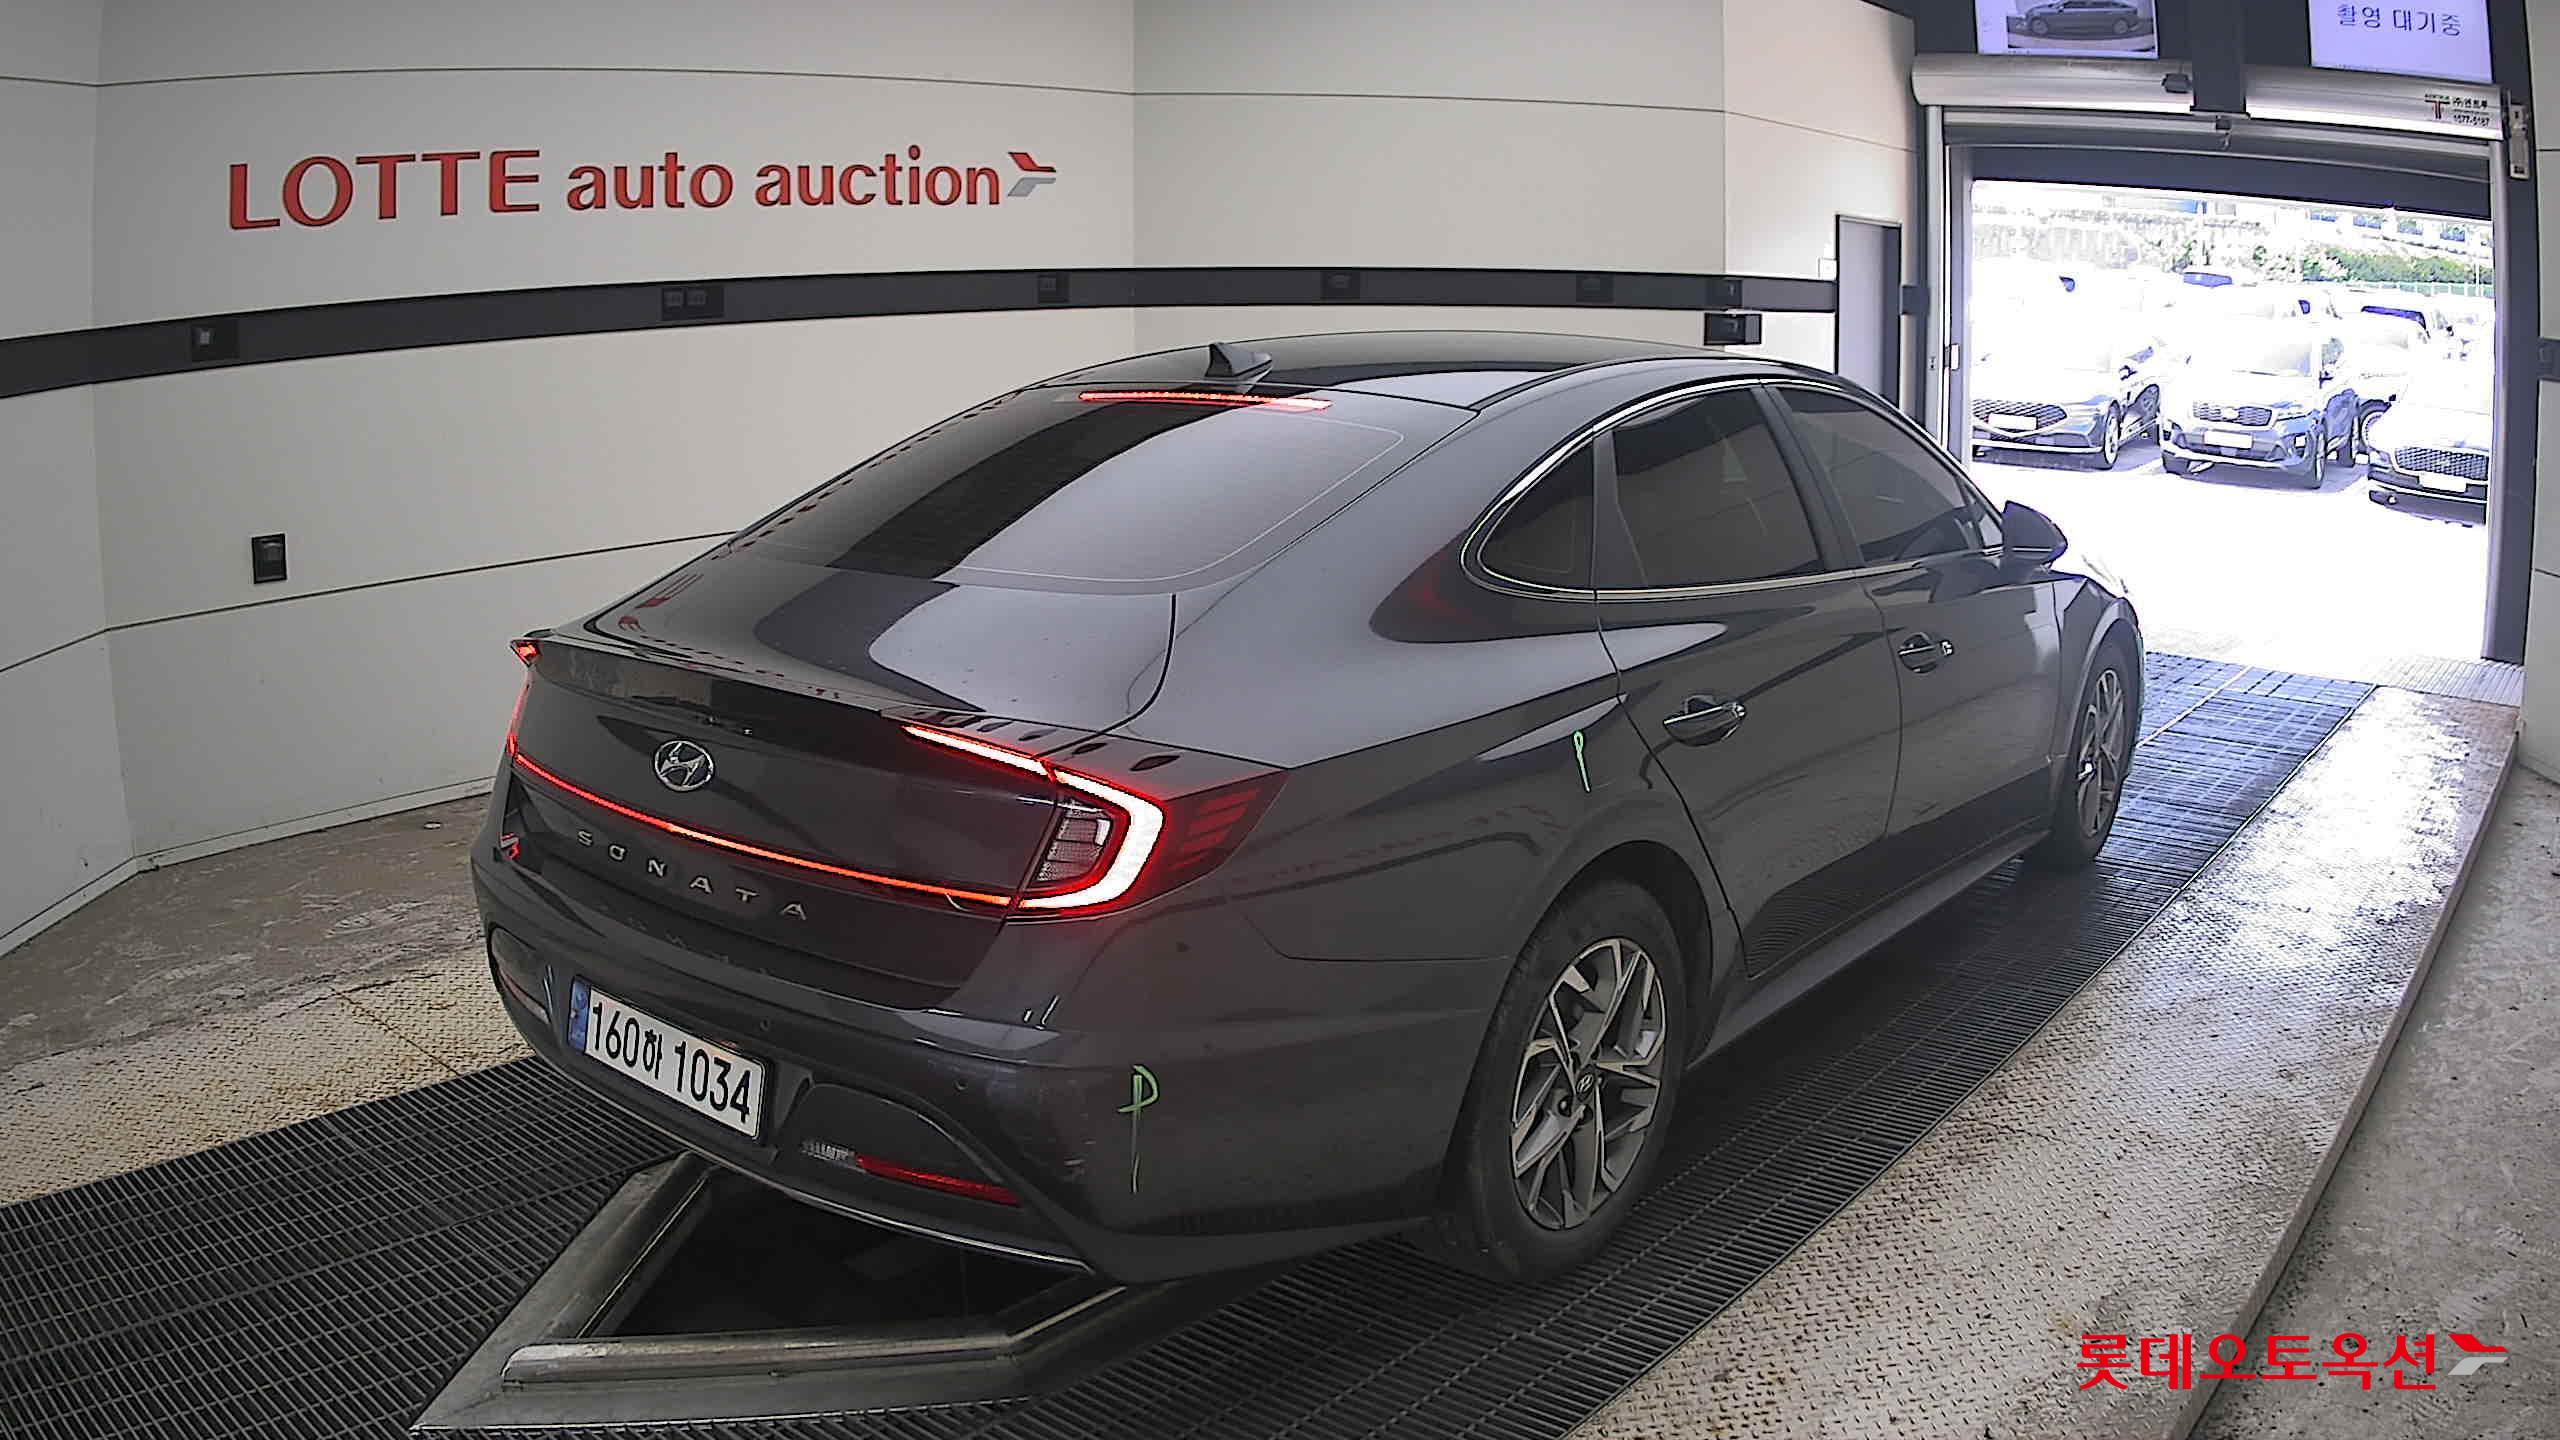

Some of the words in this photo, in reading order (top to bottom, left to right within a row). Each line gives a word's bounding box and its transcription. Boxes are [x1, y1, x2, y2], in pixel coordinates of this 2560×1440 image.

[2392, 9, 2463, 37] 대기중
[229, 150, 540, 230] LOTTE
[567, 152, 734, 211] auto
[754, 144, 1000, 206] auction
[577, 830, 808, 921] SONATA
[592, 1001, 663, 1080] 160하
[674, 1041, 752, 1124] 1034
